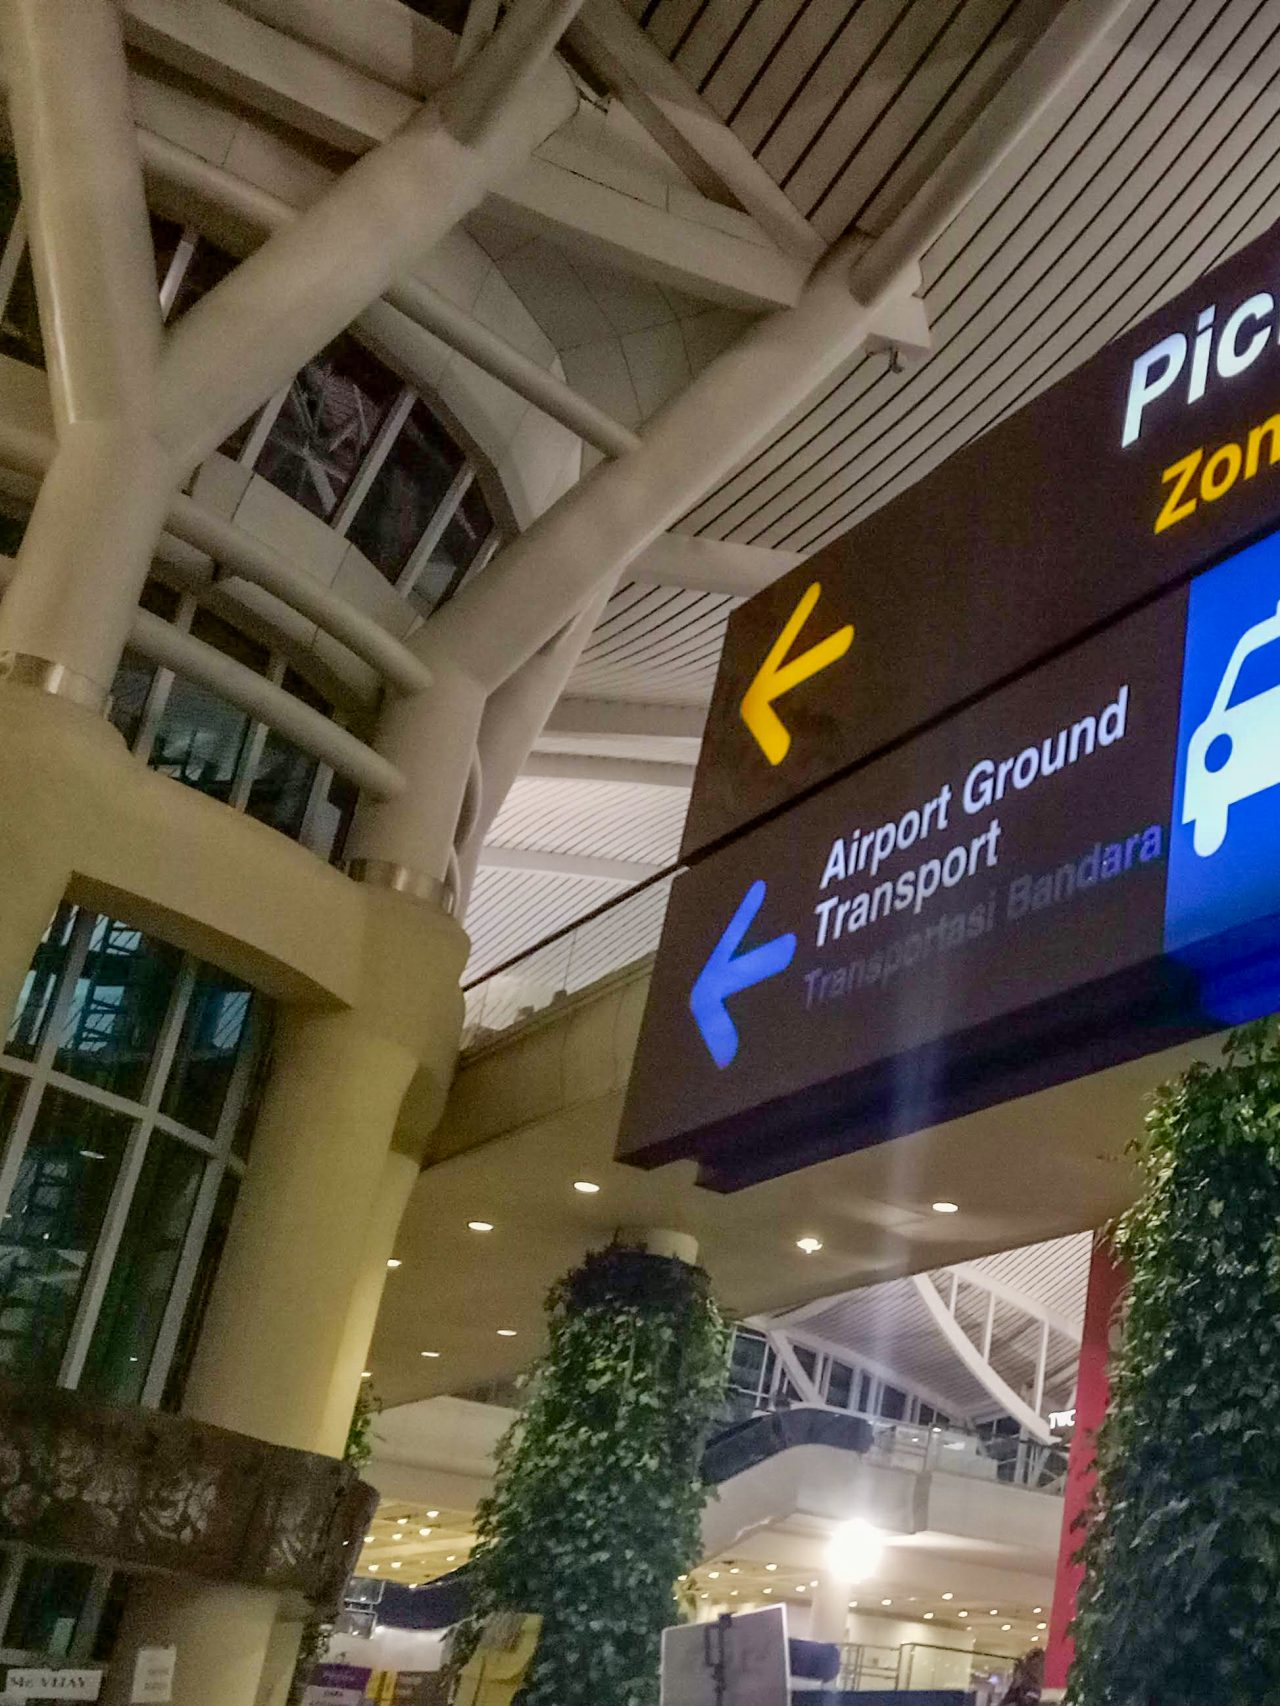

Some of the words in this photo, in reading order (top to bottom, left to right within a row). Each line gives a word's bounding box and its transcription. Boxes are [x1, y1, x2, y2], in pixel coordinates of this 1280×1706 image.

[819, 784, 952, 890] Airport
[963, 684, 1129, 815] Ground
[804, 895, 996, 1010] Transportasi
[1007, 823, 1162, 919] Bandara
[814, 818, 1002, 947] Transport
